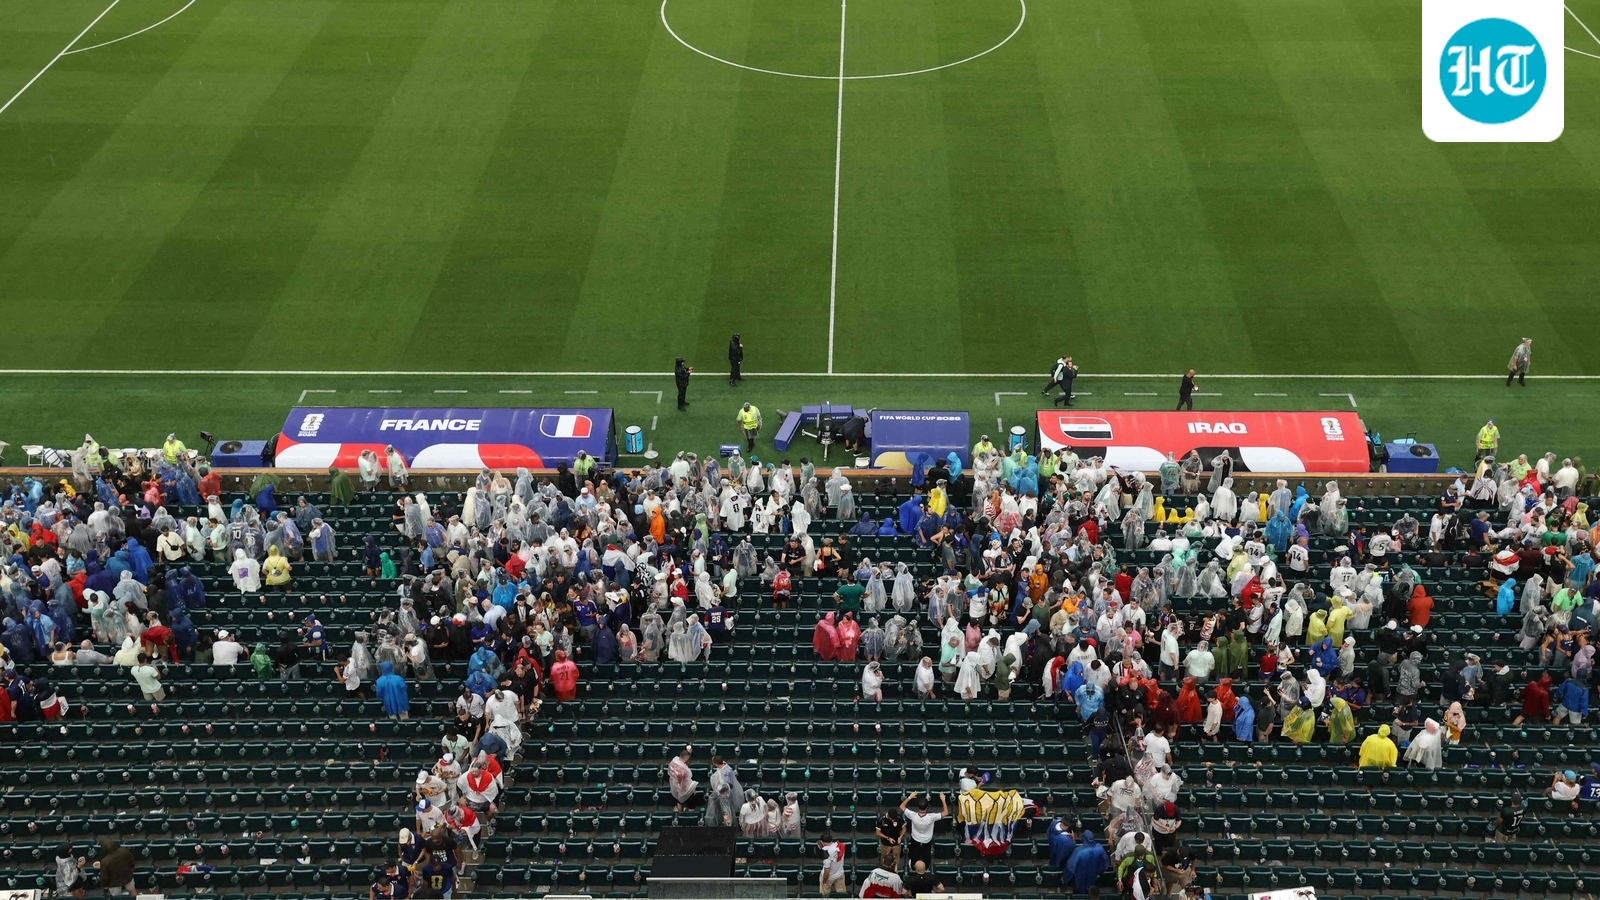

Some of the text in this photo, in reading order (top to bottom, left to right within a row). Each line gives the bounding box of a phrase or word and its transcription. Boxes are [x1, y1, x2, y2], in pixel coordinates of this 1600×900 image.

[380, 419, 482, 431] FRANCE
[1187, 422, 1248, 434] IRAQ
[1249, 547, 1260, 557] 14
[1379, 542, 1386, 551] 5
[1292, 550, 1302, 562] 14
[1272, 594, 1279, 602] 3
[1511, 815, 1524, 827] 17
